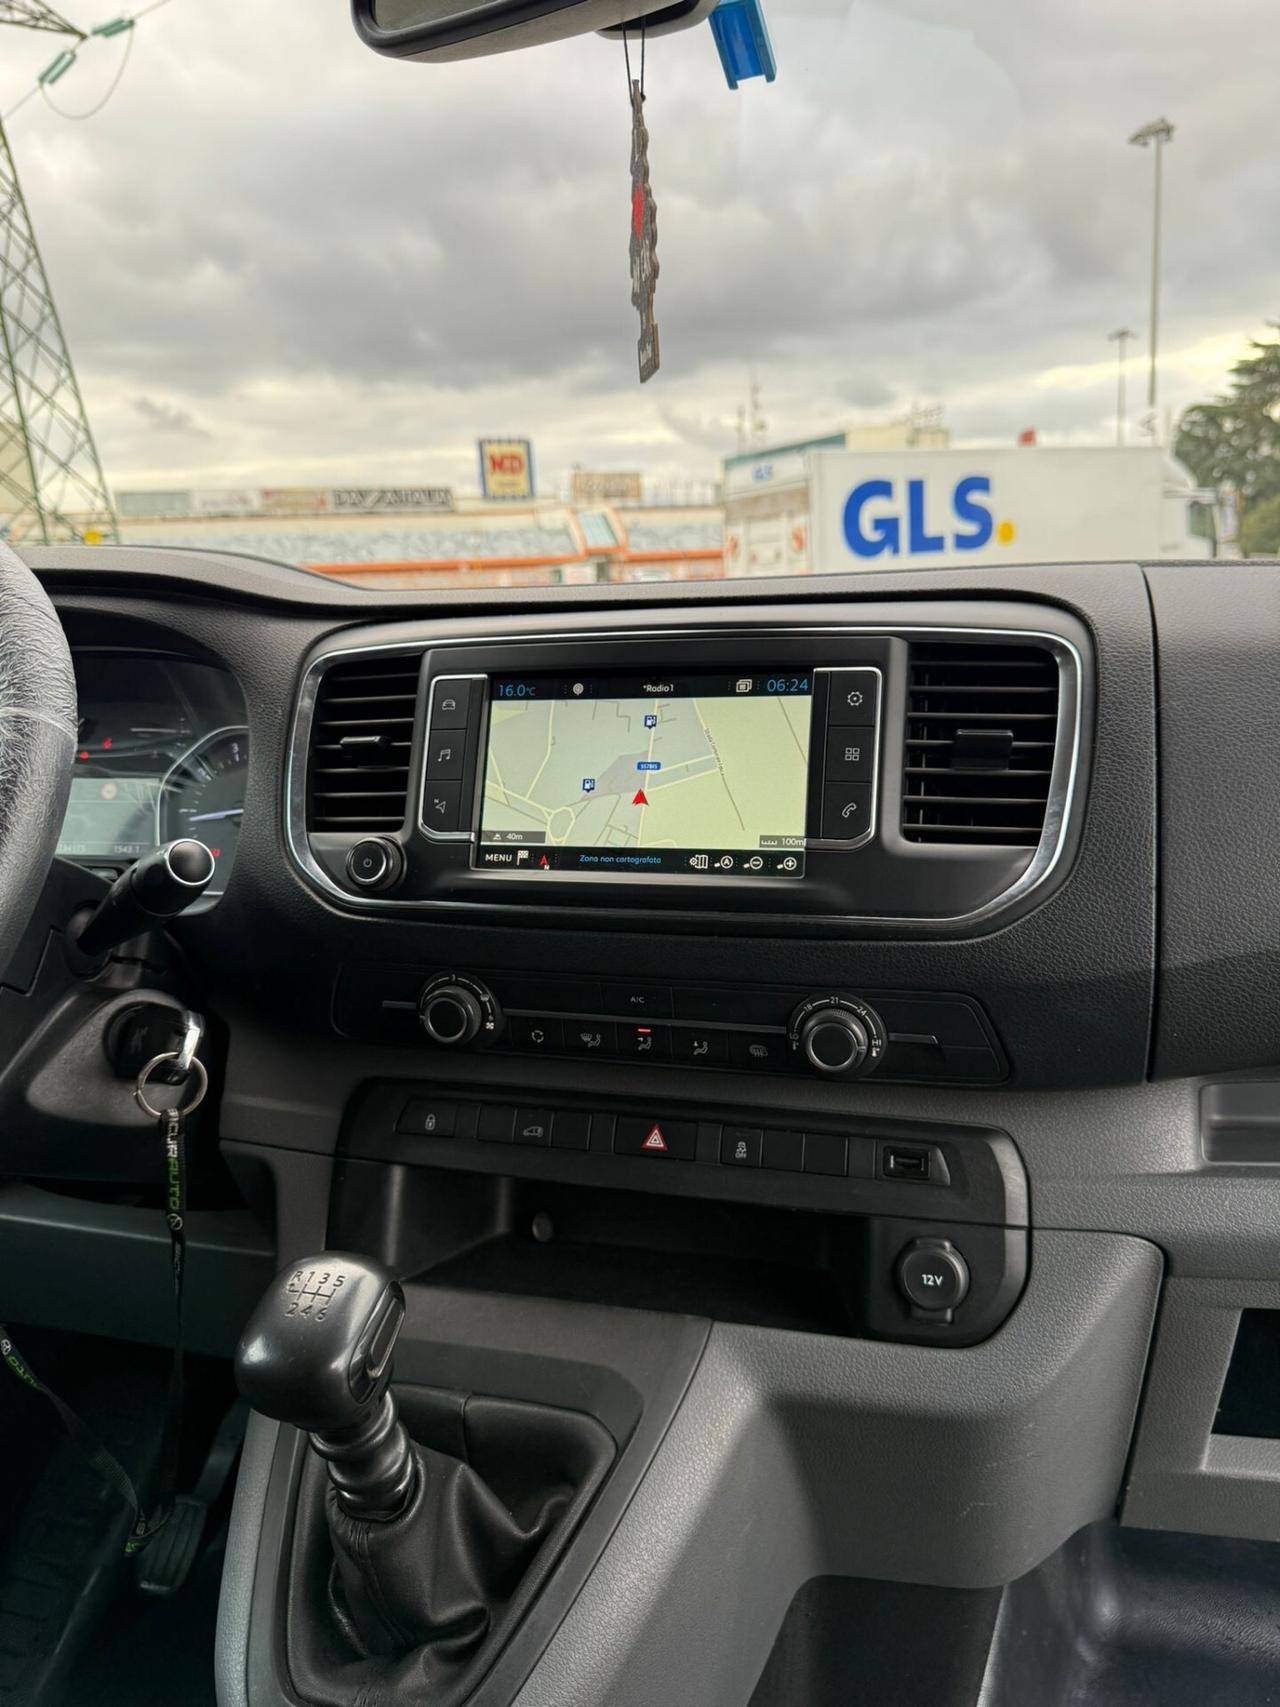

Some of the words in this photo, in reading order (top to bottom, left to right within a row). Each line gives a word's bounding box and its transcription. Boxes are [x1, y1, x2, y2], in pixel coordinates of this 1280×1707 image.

[766, 678, 808, 692] 06:24
[506, 832, 523, 841] 40m
[485, 853, 512, 863] MENU
[580, 855, 598, 863] Zona
[616, 855, 662, 866] cartografata
[829, 996, 840, 1005] 21
[856, 1006, 867, 1017] 24
[292, 1270, 304, 1282] R
[306, 1271, 316, 1283] 1
[318, 1272, 331, 1284] 3
[333, 1275, 347, 1288] 5
[921, 1273, 943, 1286] 12V
[285, 1302, 299, 1317] 2
[300, 1304, 313, 1317] 4
[315, 1307, 328, 1322] 6
